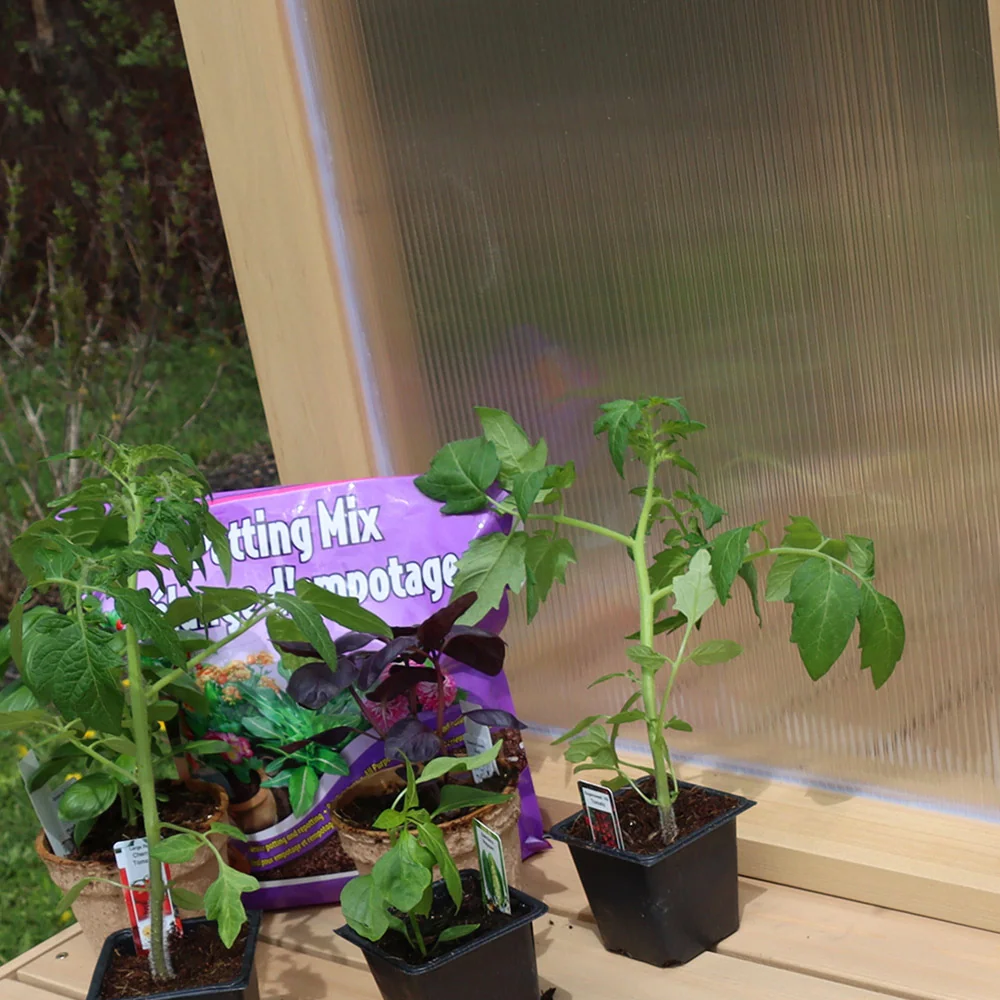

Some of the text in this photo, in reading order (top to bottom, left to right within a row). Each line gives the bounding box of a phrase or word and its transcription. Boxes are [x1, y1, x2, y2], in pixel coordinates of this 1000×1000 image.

[194, 496, 384, 563] tting Mix
[265, 552, 459, 617] d'mpotage
